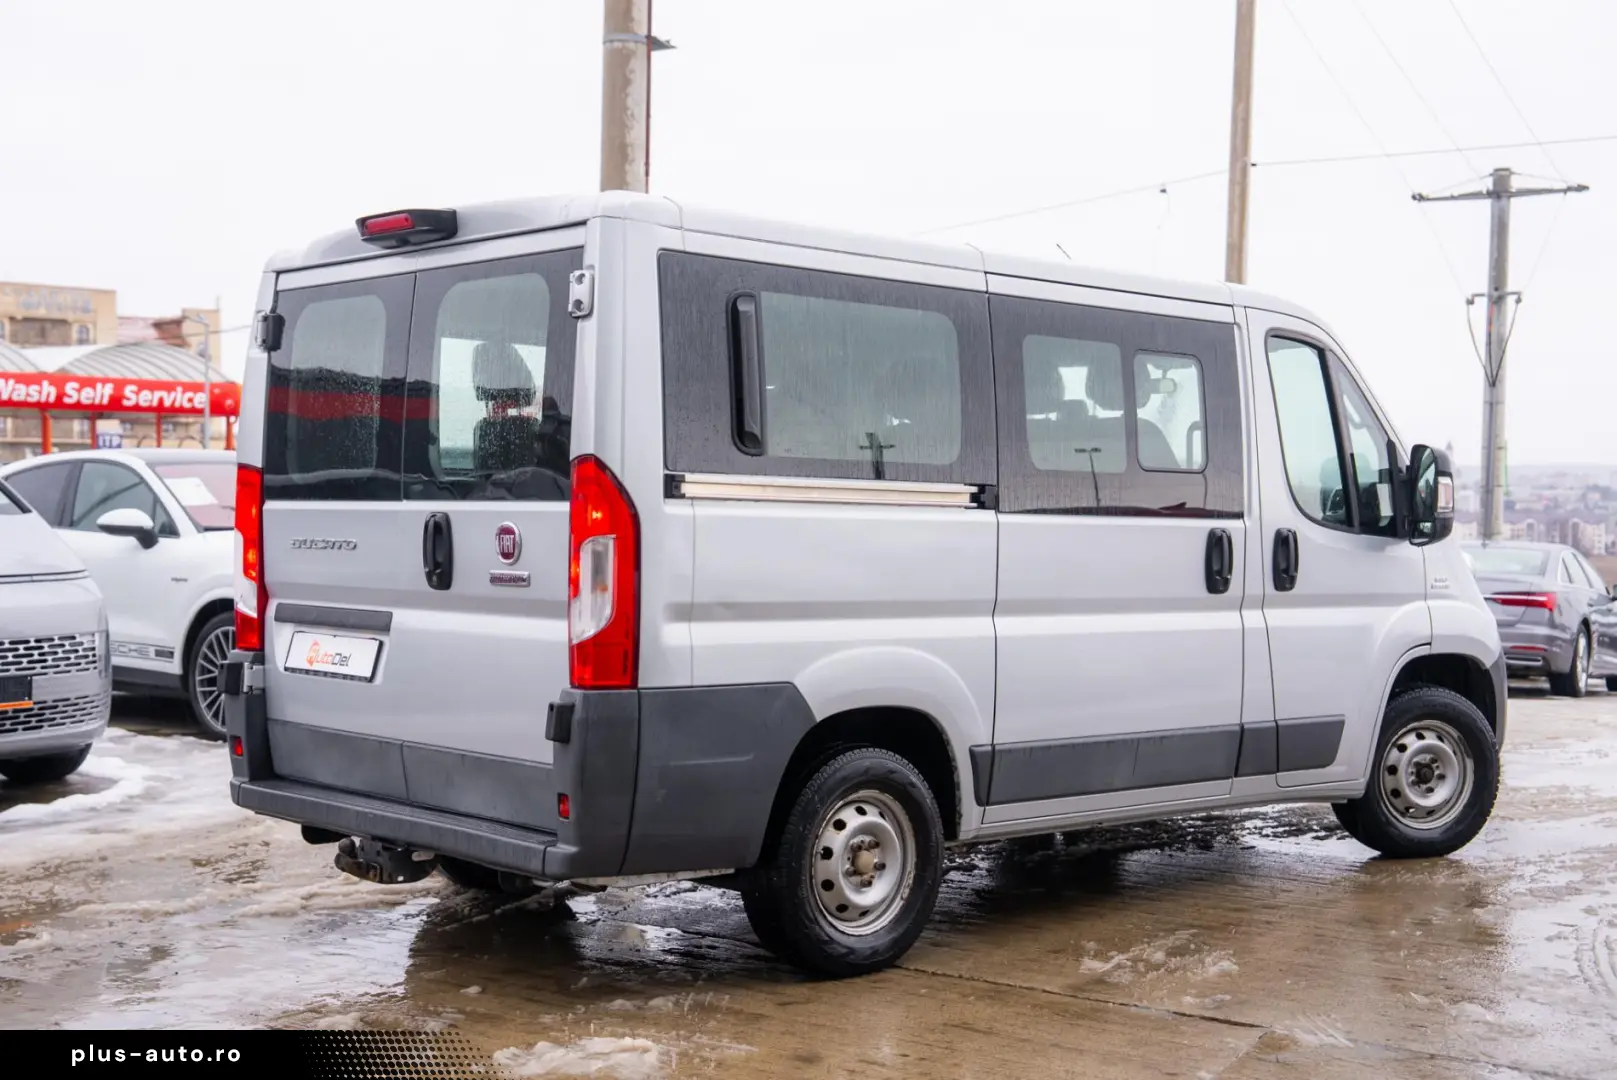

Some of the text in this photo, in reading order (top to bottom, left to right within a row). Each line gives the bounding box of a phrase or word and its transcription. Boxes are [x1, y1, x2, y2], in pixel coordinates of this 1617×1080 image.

[63, 381, 114, 405] Self
[122, 385, 207, 409] Service
[98, 436, 121, 447] ITP
[500, 534, 514, 553] FIAT
